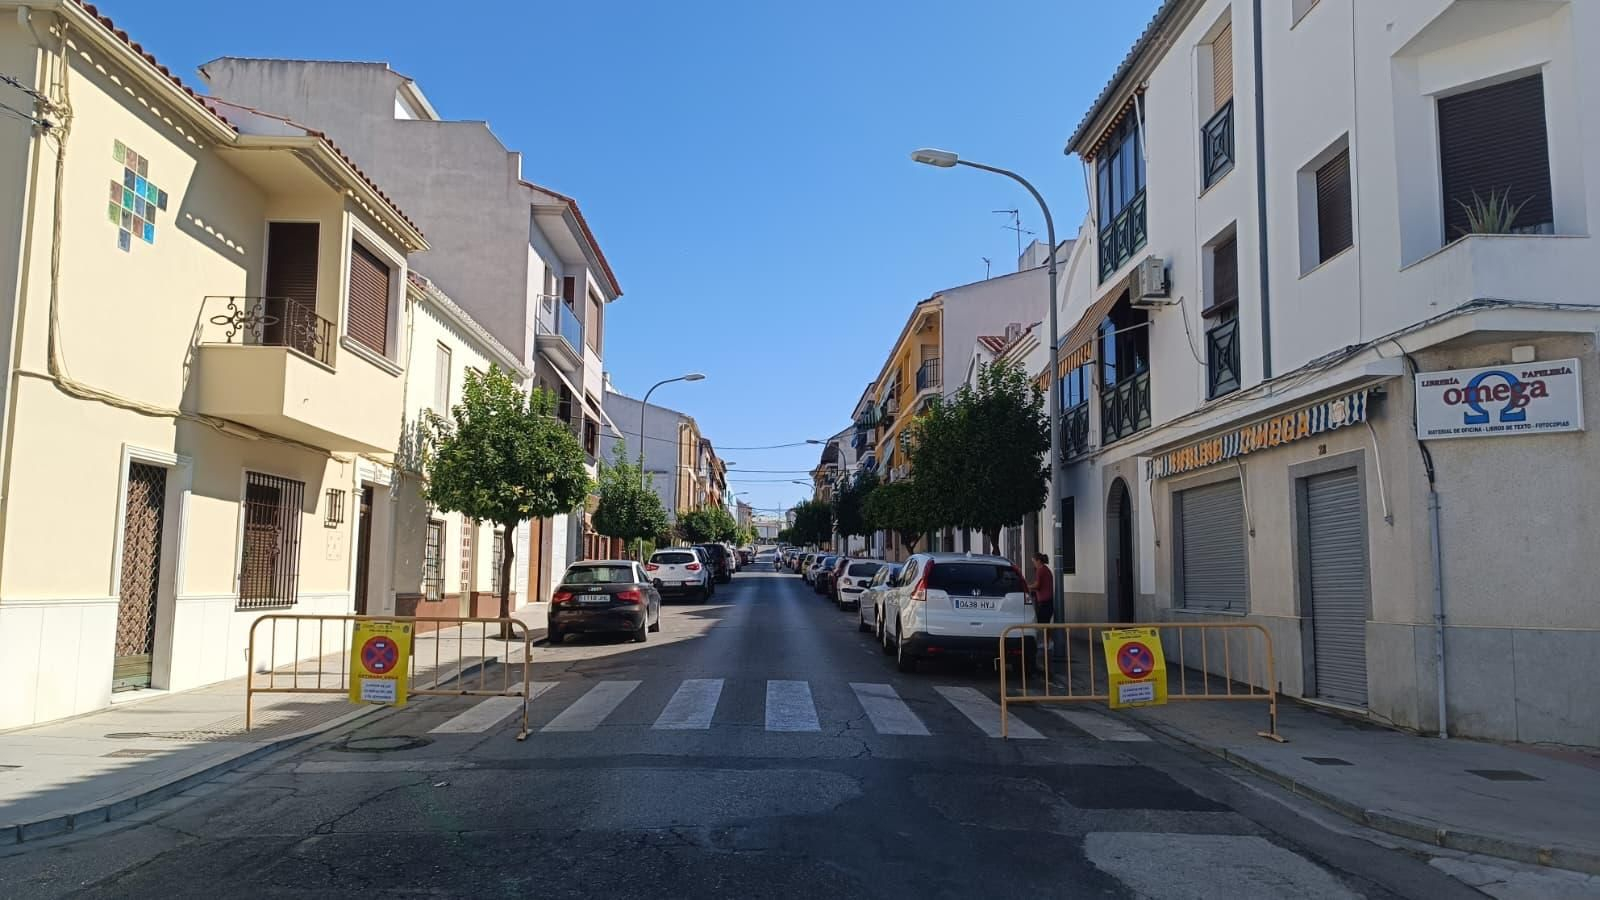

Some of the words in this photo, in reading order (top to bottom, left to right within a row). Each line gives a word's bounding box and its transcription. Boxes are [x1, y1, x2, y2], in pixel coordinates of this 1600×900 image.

[1443, 379, 1549, 408] omega
[1240, 410, 1310, 454] OMEGA
[960, 600, 978, 608] 0438
